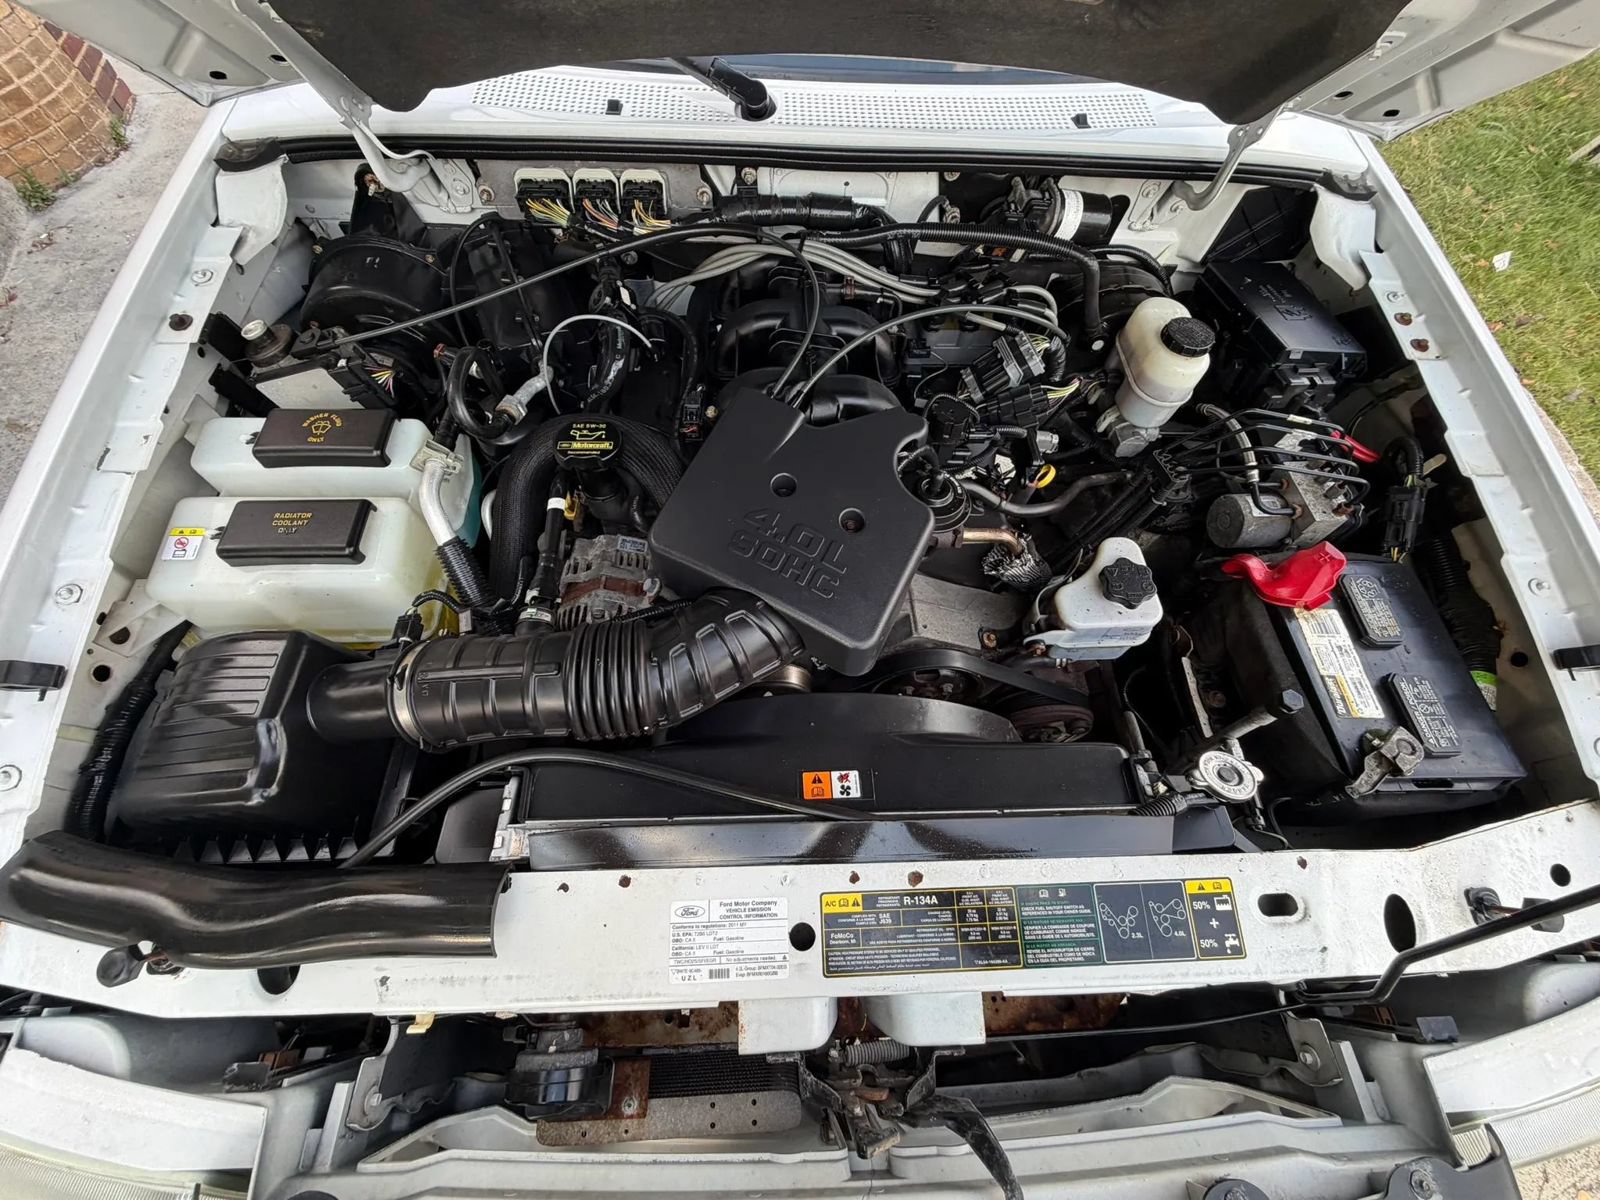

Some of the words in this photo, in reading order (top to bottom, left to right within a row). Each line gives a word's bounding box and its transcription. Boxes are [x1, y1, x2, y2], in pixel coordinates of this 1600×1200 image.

[302, 413, 328, 427] WASHER
[743, 507, 847, 575] 4.0L
[904, 896, 938, 905] R-134A
[1193, 901, 1211, 910] 50%
[1200, 939, 1218, 948] 50%
